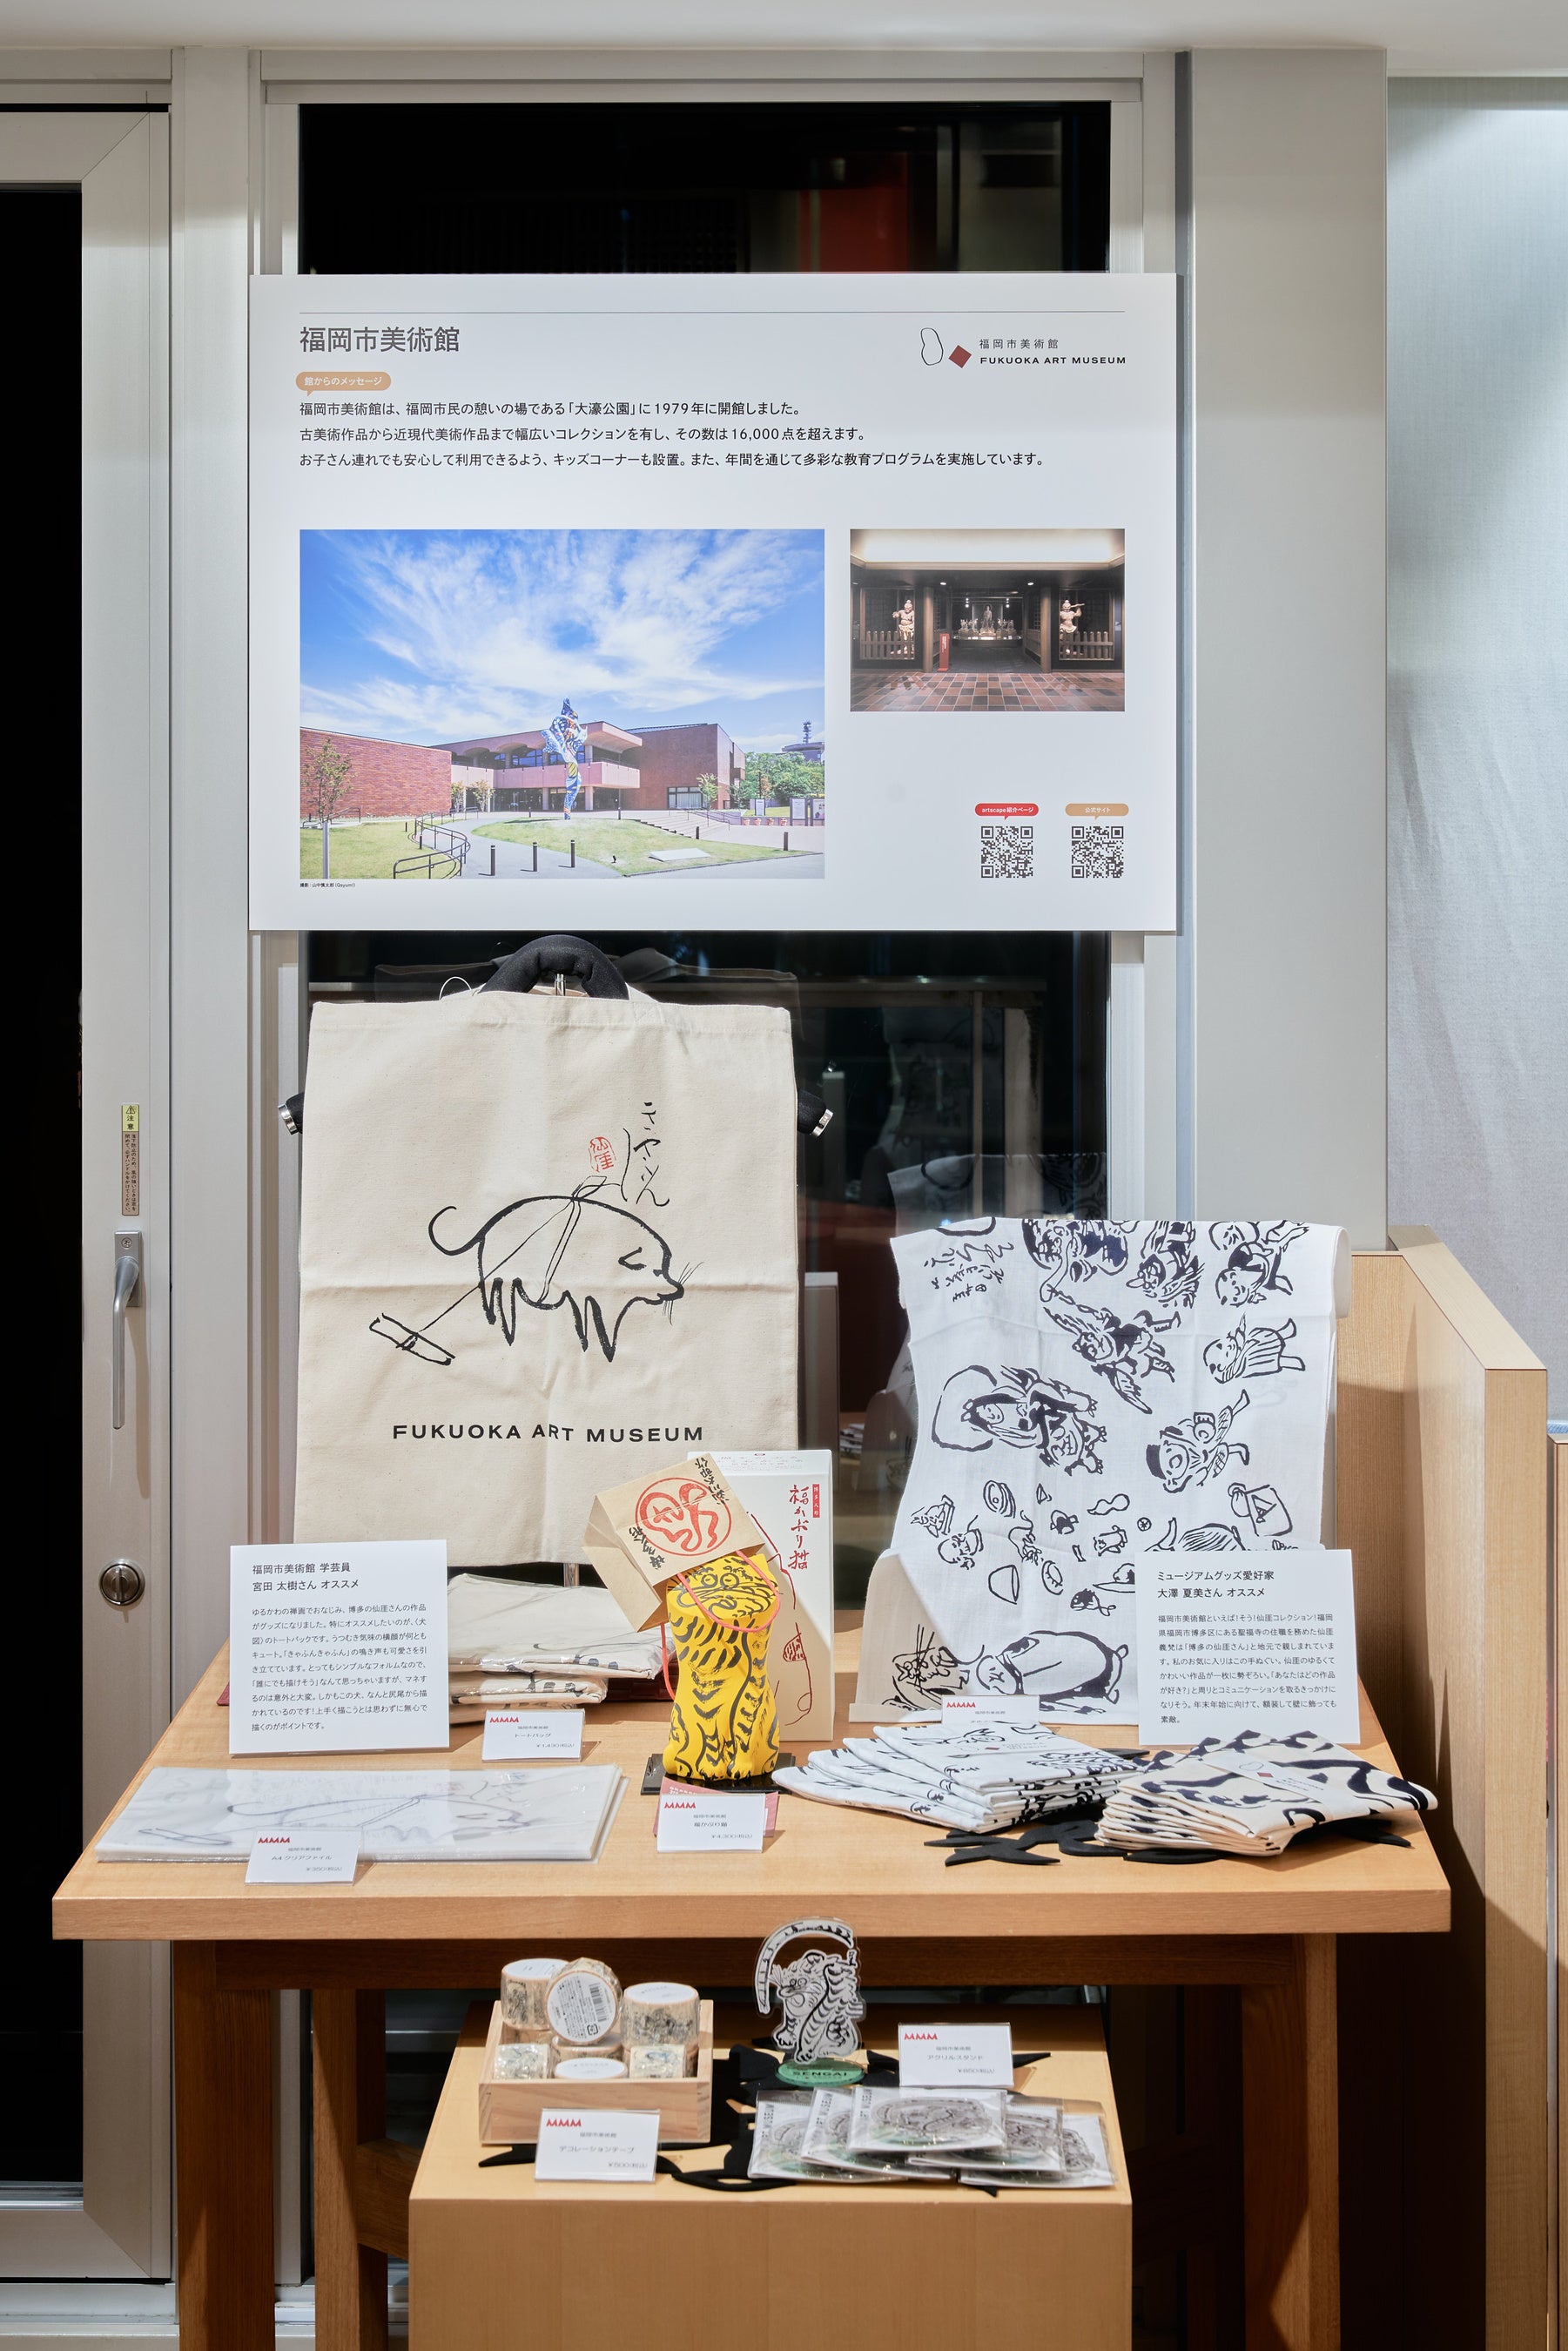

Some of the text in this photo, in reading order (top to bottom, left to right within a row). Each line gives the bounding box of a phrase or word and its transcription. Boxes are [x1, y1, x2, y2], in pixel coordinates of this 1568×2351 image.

[299, 326, 461, 353] 福岡市美術館
[979, 338, 1059, 350] 福岡市美術館
[979, 356, 1126, 365] FUKUOKA ART MUSEUM
[304, 376, 382, 387] 館からのメッセージ
[126, 1115, 135, 1130] 注意
[393, 1423, 703, 1444] FUKUOKA ART MUSEUM
[252, 1561, 352, 1575] 福岡市美術館 学芸員
[1157, 1569, 1275, 1581] ミュージアムグッズ愛好家
[252, 1579, 359, 1593] 宮田 太樹さん オススメ
[1182, 1587, 1223, 1599] 夏美さん
[1227, 1587, 1265, 1598] オススメ
[1161, 1714, 1181, 1724] 素敵。
